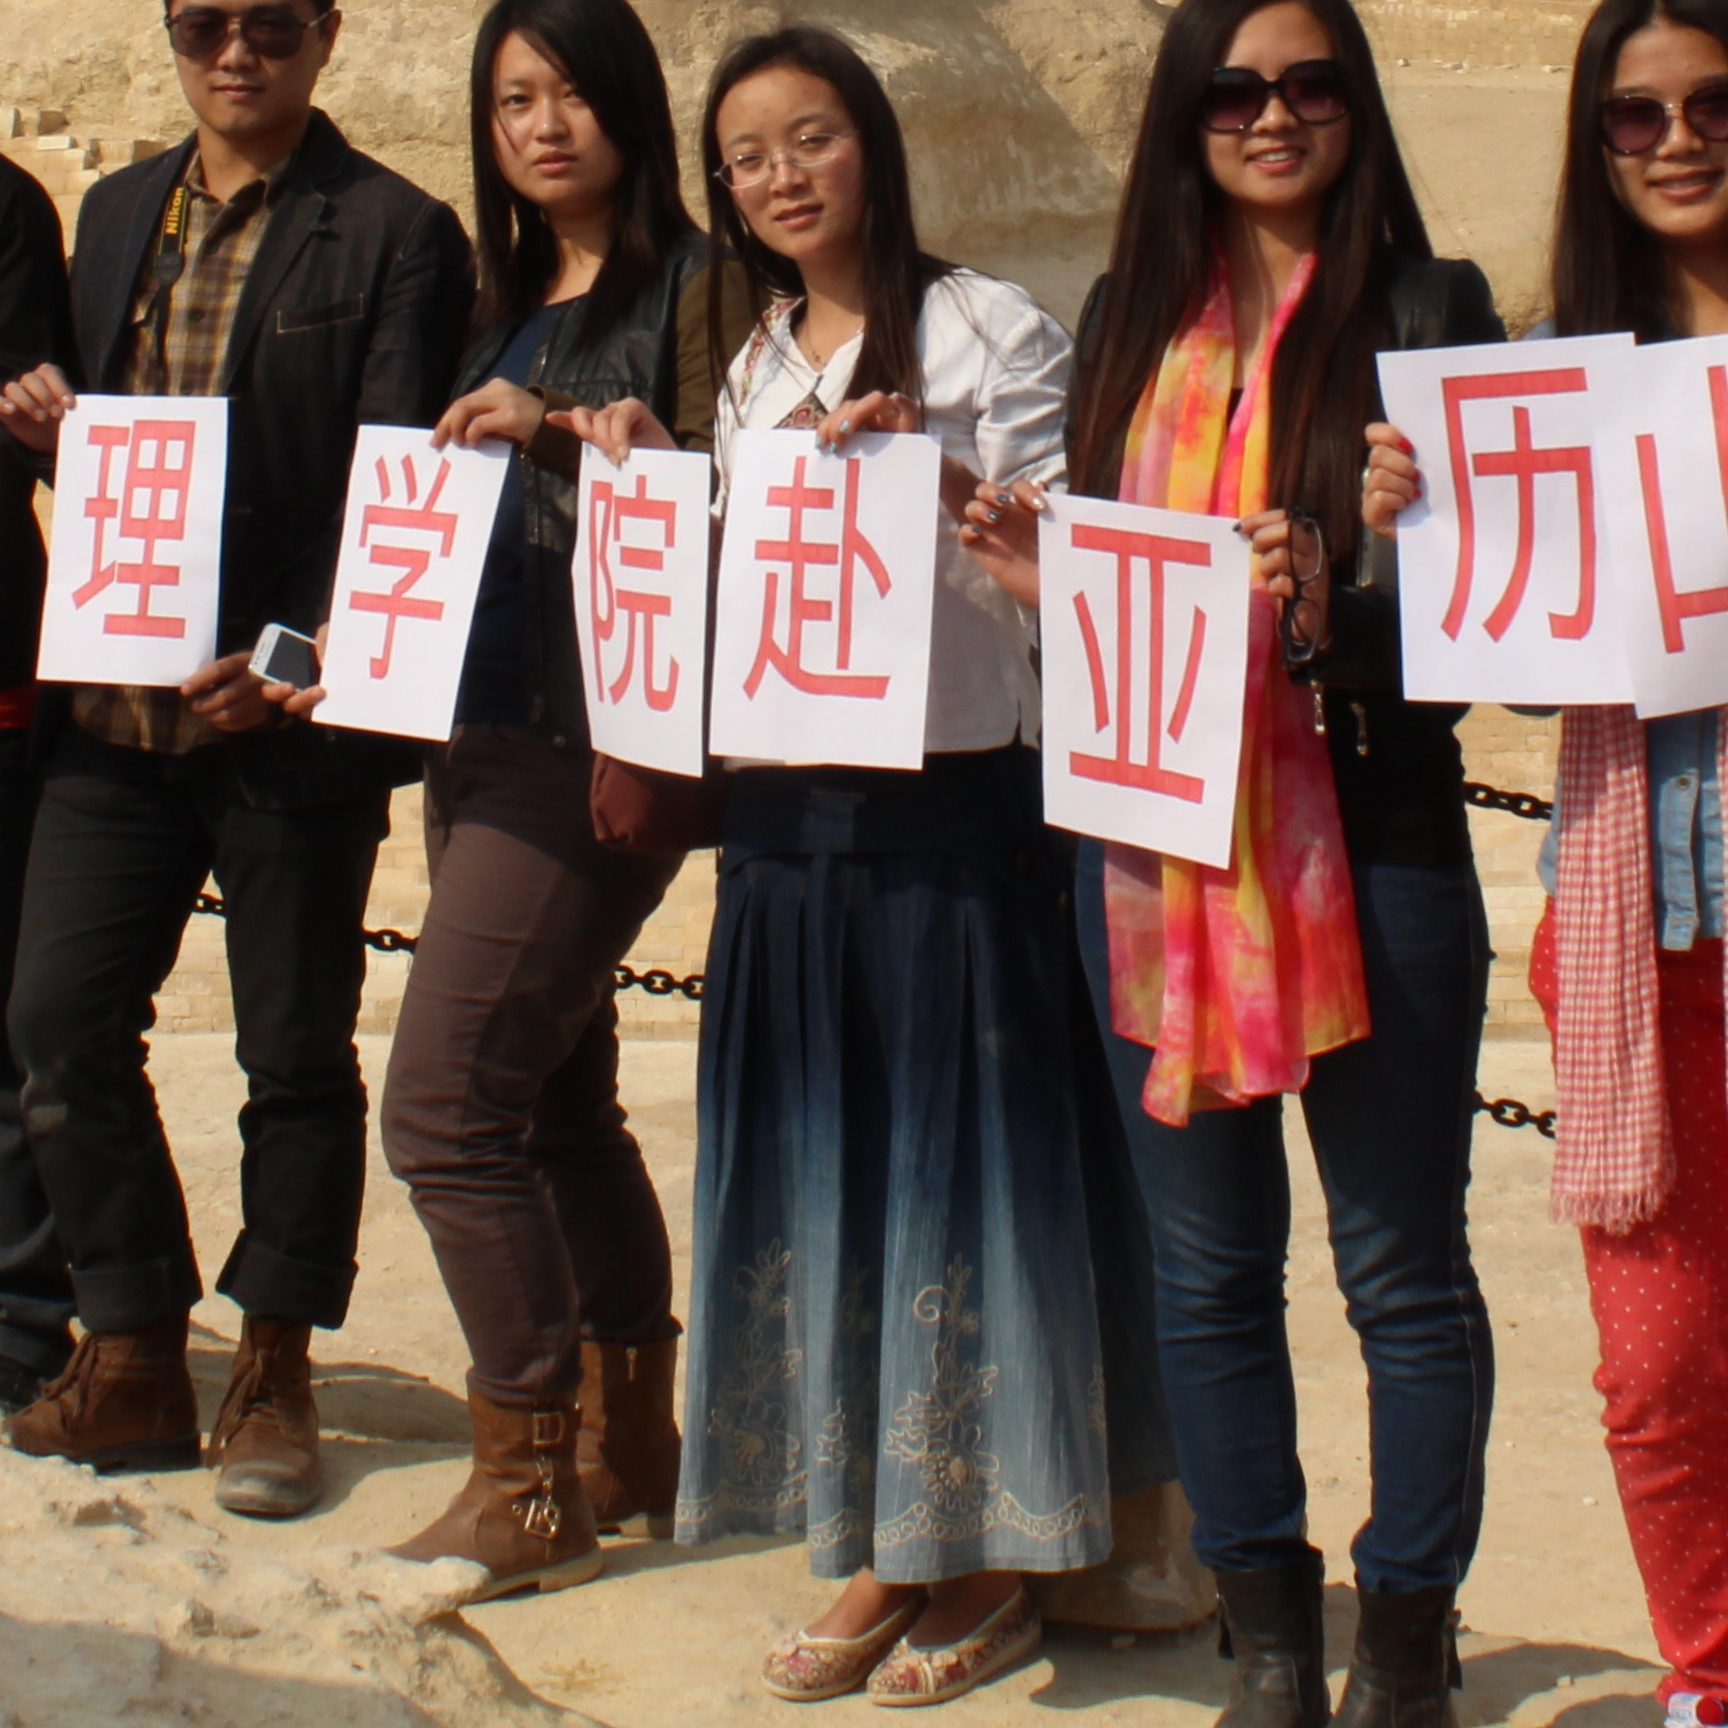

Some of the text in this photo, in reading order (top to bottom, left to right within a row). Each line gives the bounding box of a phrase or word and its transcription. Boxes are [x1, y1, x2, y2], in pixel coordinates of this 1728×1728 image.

[165, 187, 185, 235] Nikon
[73, 419, 196, 639] 理
[349, 455, 459, 679] 学
[589, 475, 680, 712] 院
[743, 456, 892, 700] 赴
[1441, 367, 1597, 642] 历
[1070, 523, 1212, 804] 亚
